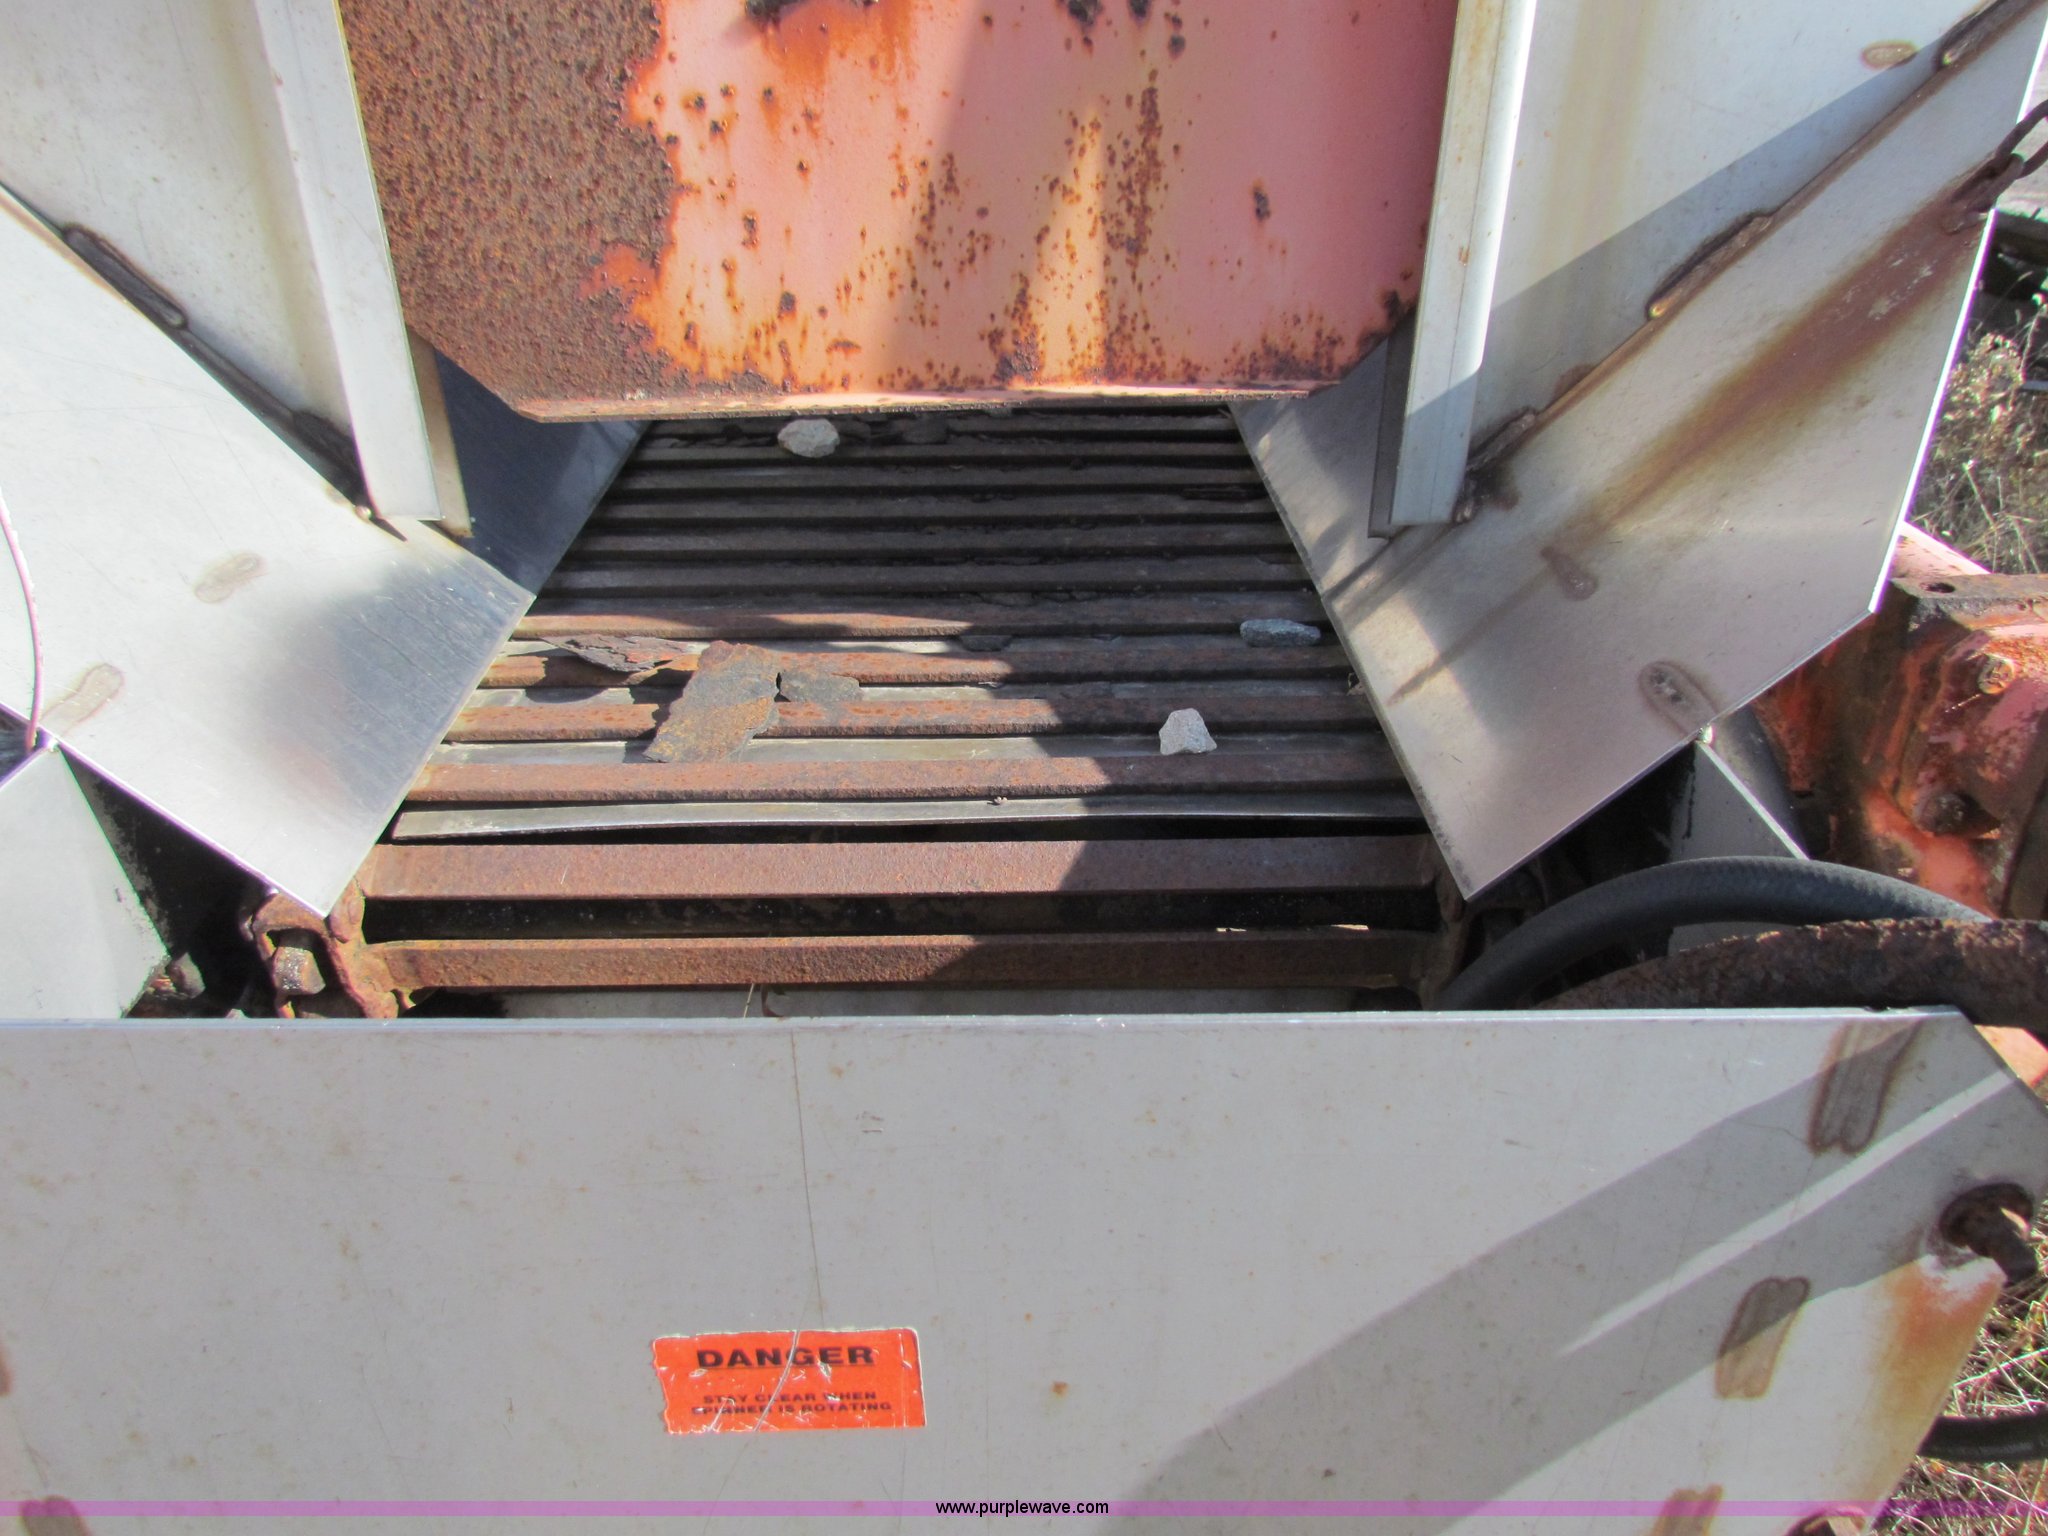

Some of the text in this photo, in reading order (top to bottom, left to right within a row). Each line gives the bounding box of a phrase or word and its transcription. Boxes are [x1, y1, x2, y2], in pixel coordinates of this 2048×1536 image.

[697, 1346, 874, 1367] DANGER
[703, 1394, 748, 1404] STAY
[755, 1393, 816, 1403] CLEAR
[779, 1404, 795, 1413] IS
[801, 1402, 892, 1413] ROTATING
